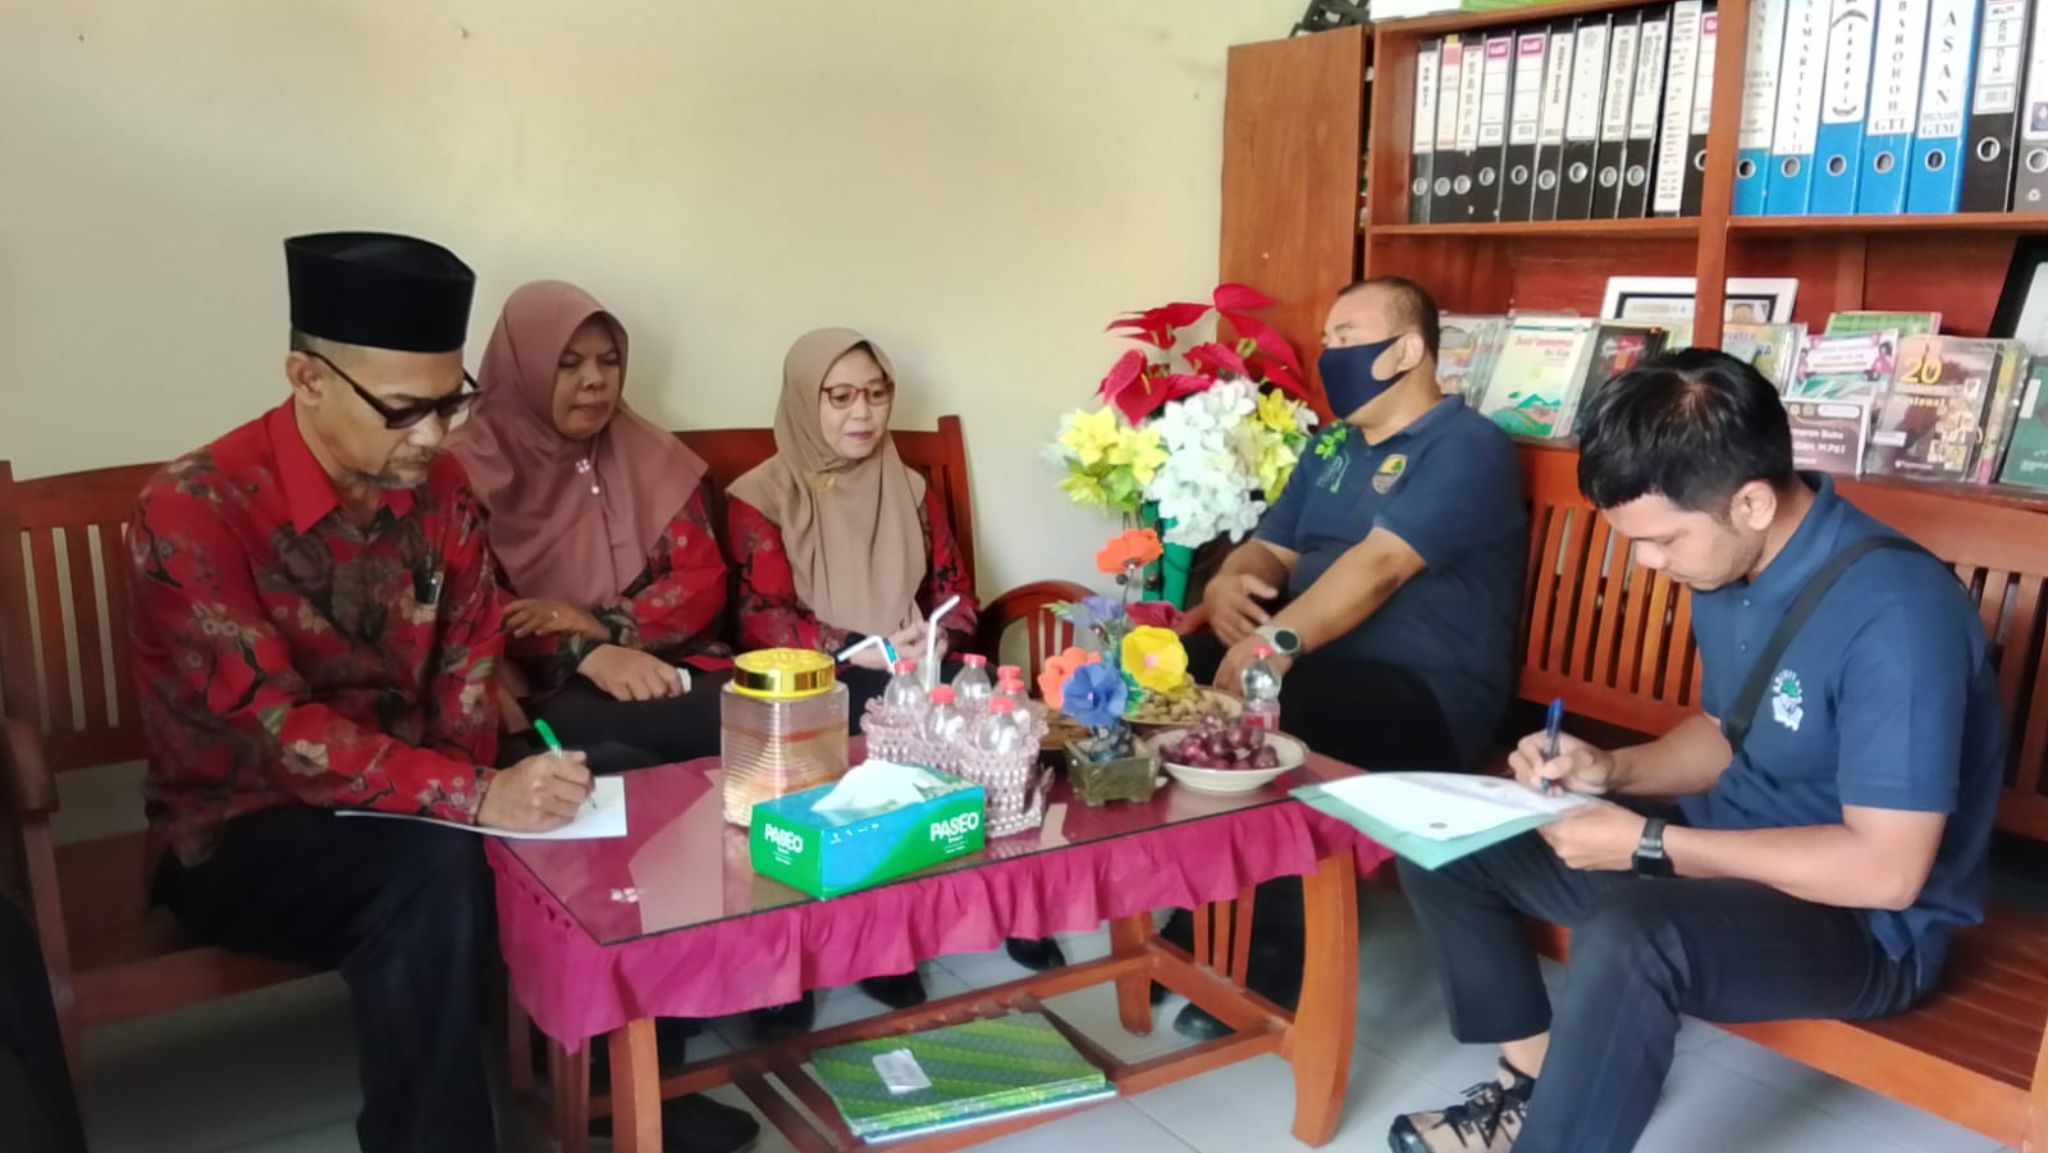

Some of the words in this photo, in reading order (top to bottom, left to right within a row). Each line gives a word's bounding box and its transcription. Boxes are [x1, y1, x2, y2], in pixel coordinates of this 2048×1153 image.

[1901, 357, 1943, 385] 20
[764, 823, 804, 854] PASEO
[930, 811, 980, 842] PASEO
